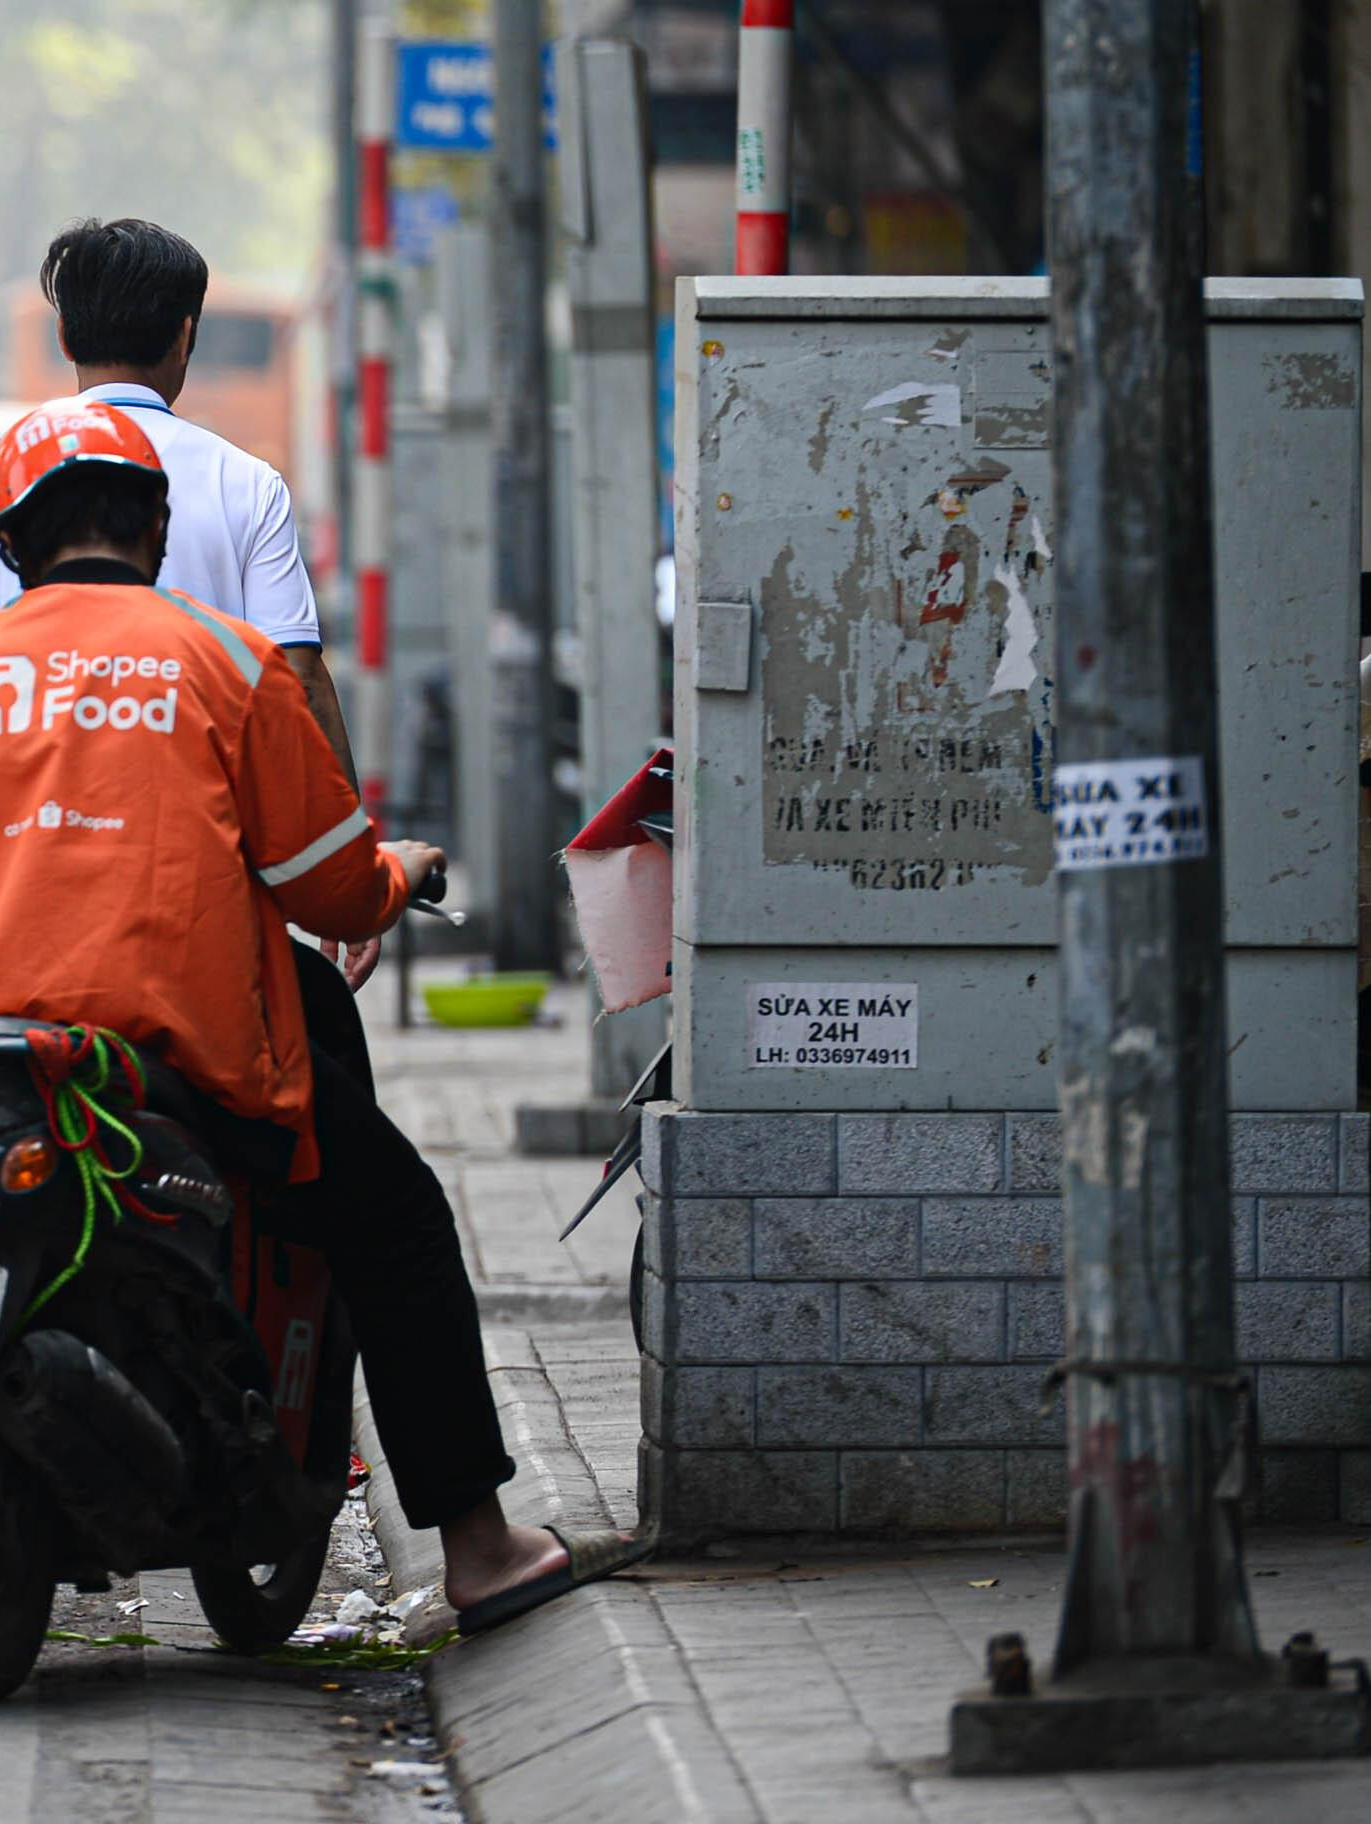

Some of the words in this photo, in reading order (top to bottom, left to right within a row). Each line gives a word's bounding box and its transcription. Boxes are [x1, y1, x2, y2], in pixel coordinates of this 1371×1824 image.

[46, 649, 181, 688] Shopee
[42, 684, 178, 733] Food
[757, 994, 811, 1017] SỬA
[817, 999, 850, 1017] XE
[858, 994, 912, 1017] MÁY
[808, 1022, 859, 1043] 24H
[756, 1047, 790, 1064] LH:
[796, 1048, 910, 1065] 0336974911
